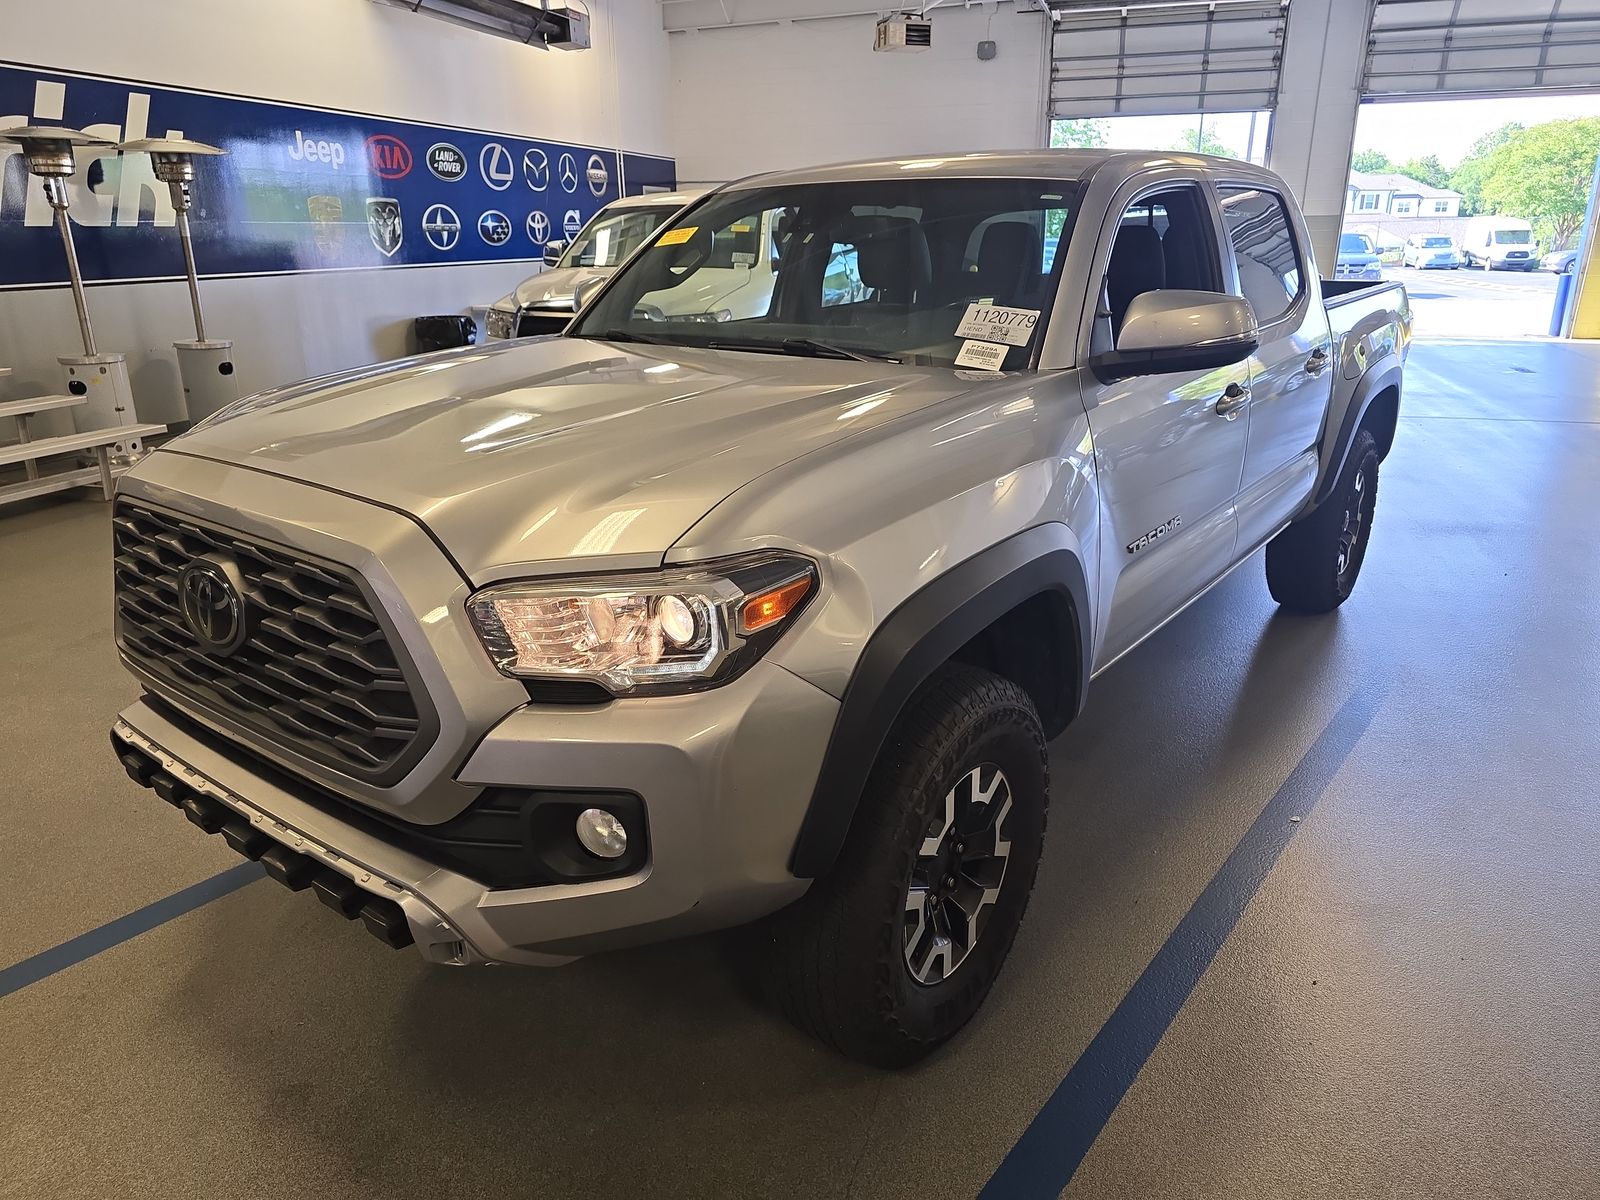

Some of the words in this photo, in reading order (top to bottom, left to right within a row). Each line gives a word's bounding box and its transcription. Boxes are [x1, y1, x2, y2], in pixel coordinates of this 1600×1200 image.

[288, 130, 345, 169] Jeep
[372, 143, 407, 169] KIA
[435, 150, 454, 161] LAND
[438, 162, 461, 173] ROVER
[587, 172, 607, 180] NISSAN
[974, 309, 1037, 328] 1120779
[1127, 515, 1182, 553] TACOMA
